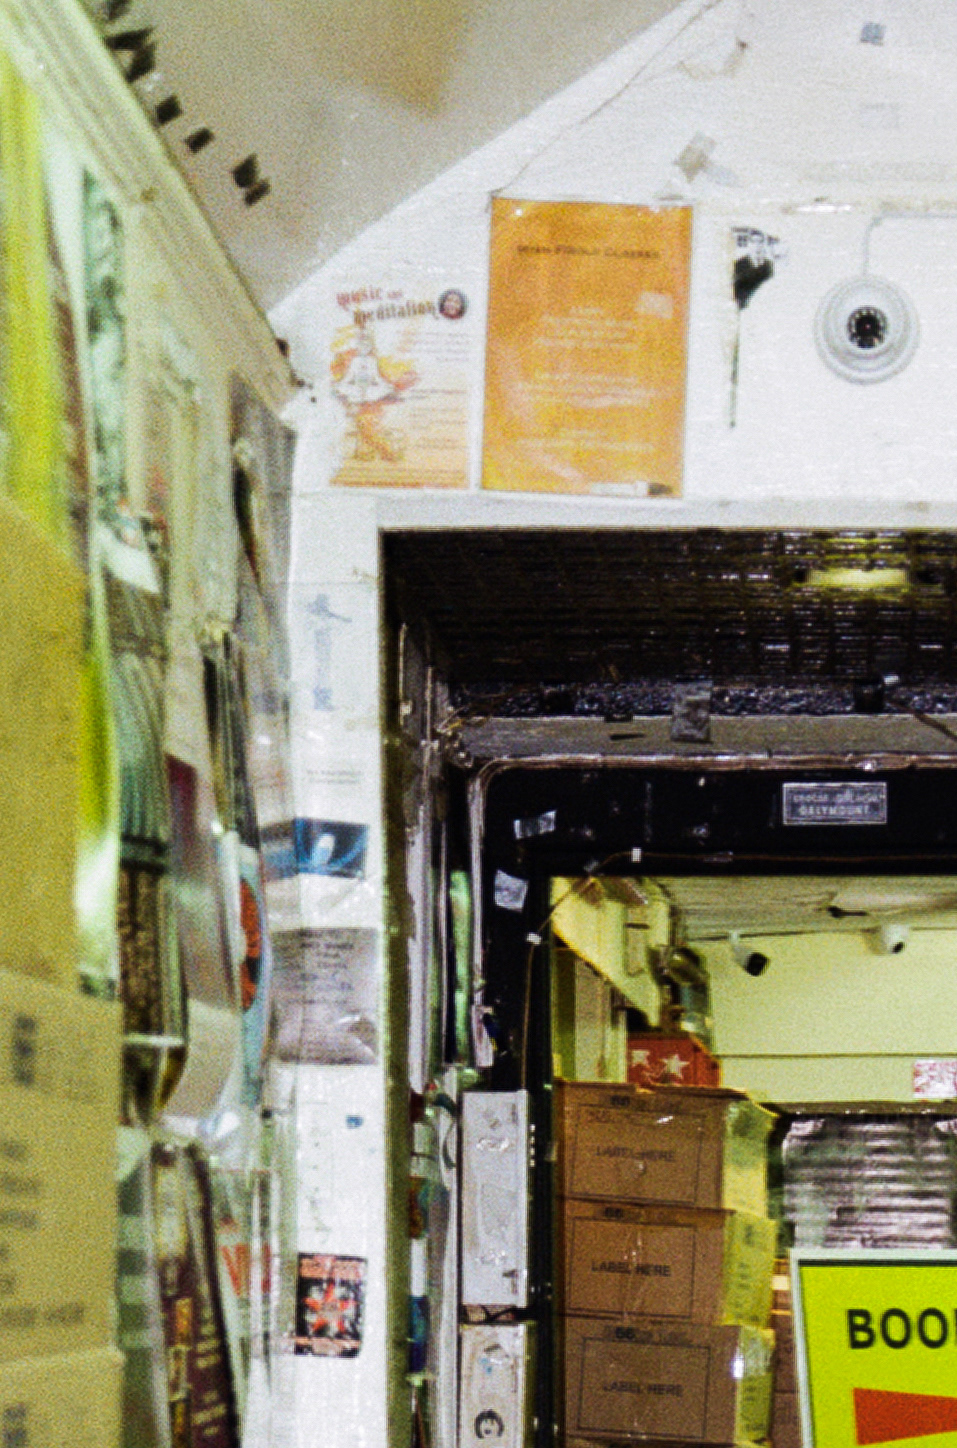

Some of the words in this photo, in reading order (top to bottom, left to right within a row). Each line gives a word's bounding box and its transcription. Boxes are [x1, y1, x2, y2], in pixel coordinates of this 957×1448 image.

[591, 1261, 632, 1276] LABEL
[635, 1263, 671, 1278] HERE
[647, 1383, 683, 1398] HERE
